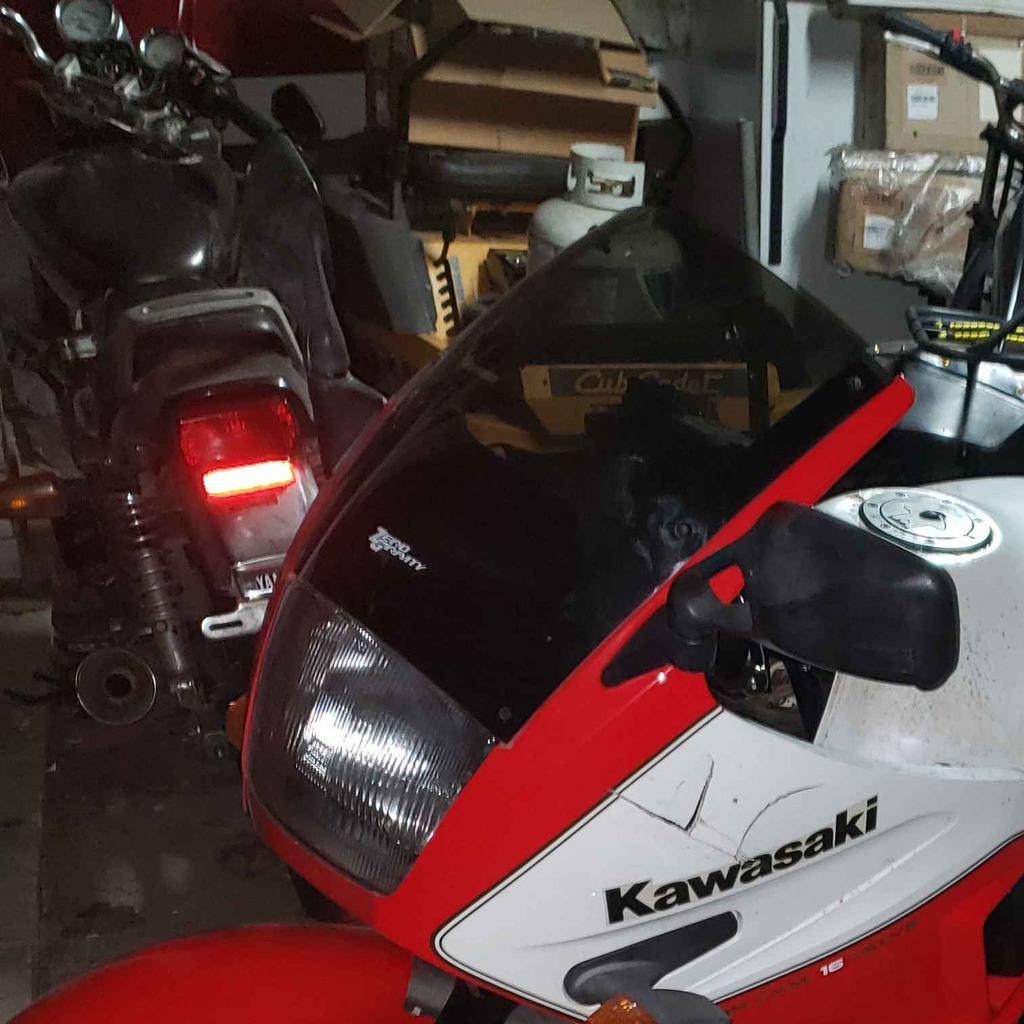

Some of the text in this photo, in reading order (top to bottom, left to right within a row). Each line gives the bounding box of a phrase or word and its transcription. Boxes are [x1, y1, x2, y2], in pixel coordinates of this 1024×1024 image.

[369, 526, 411, 553] ZERO
[370, 541, 427, 571] GRAVITY
[604, 796, 879, 924] Kawasaki
[819, 957, 845, 977] 16
